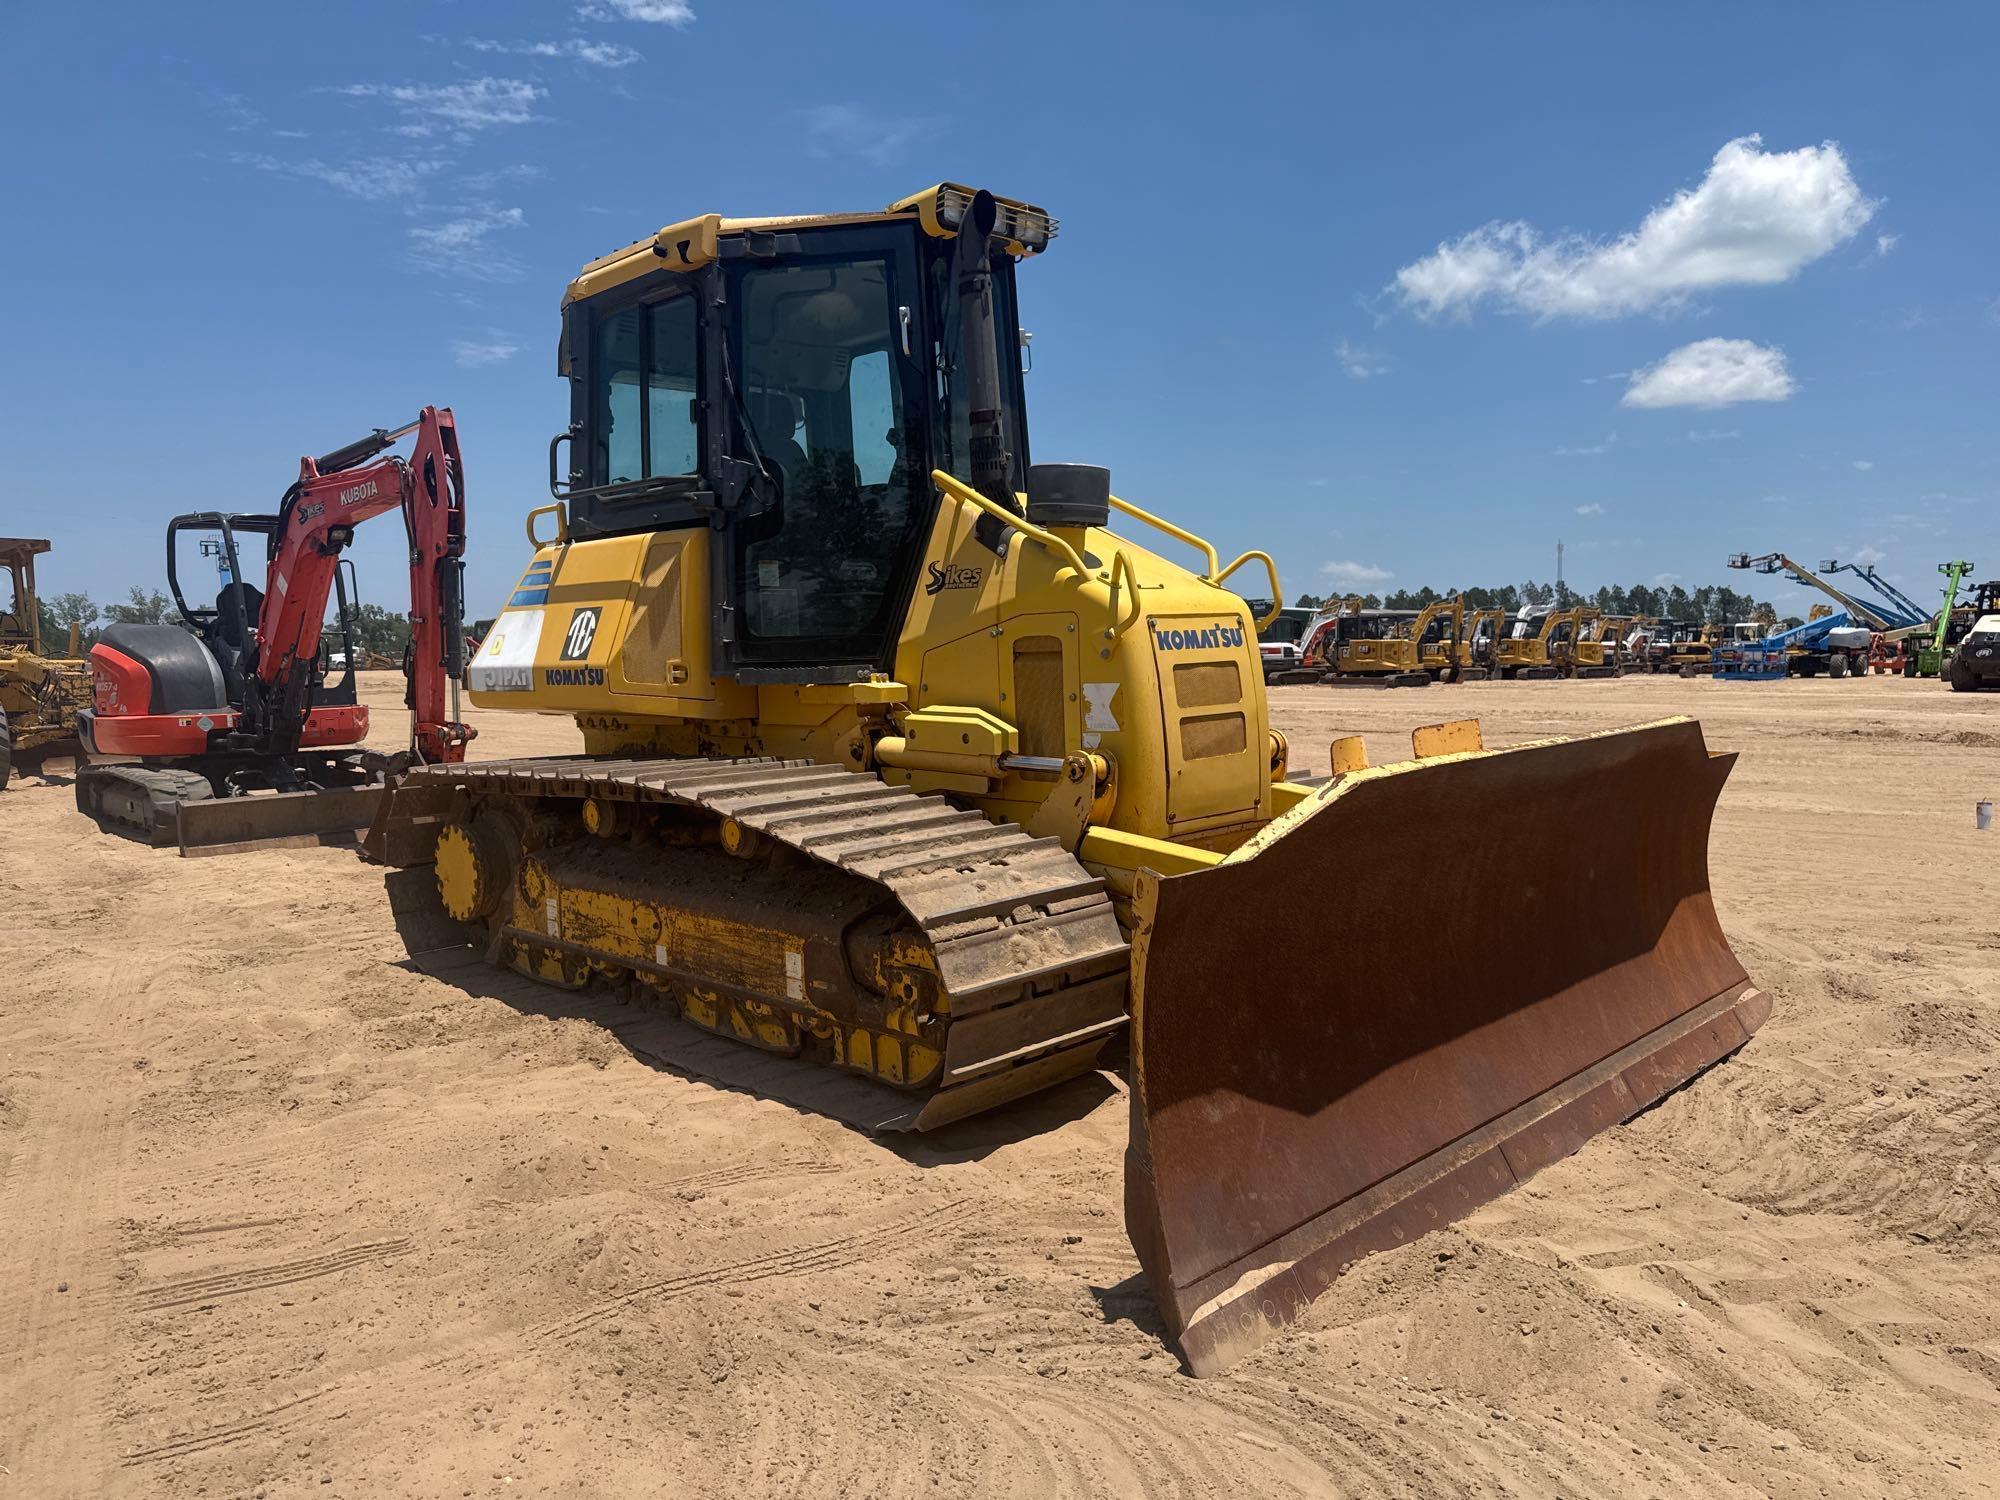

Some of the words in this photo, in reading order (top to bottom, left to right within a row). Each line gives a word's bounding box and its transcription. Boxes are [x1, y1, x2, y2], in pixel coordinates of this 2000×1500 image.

[341, 480, 378, 506] KUBOTA
[926, 561, 982, 596] Sikes
[1157, 623, 1243, 650] KOMATSU
[1426, 645, 1438, 654] CAT
[545, 664, 604, 686] KOMATSU
